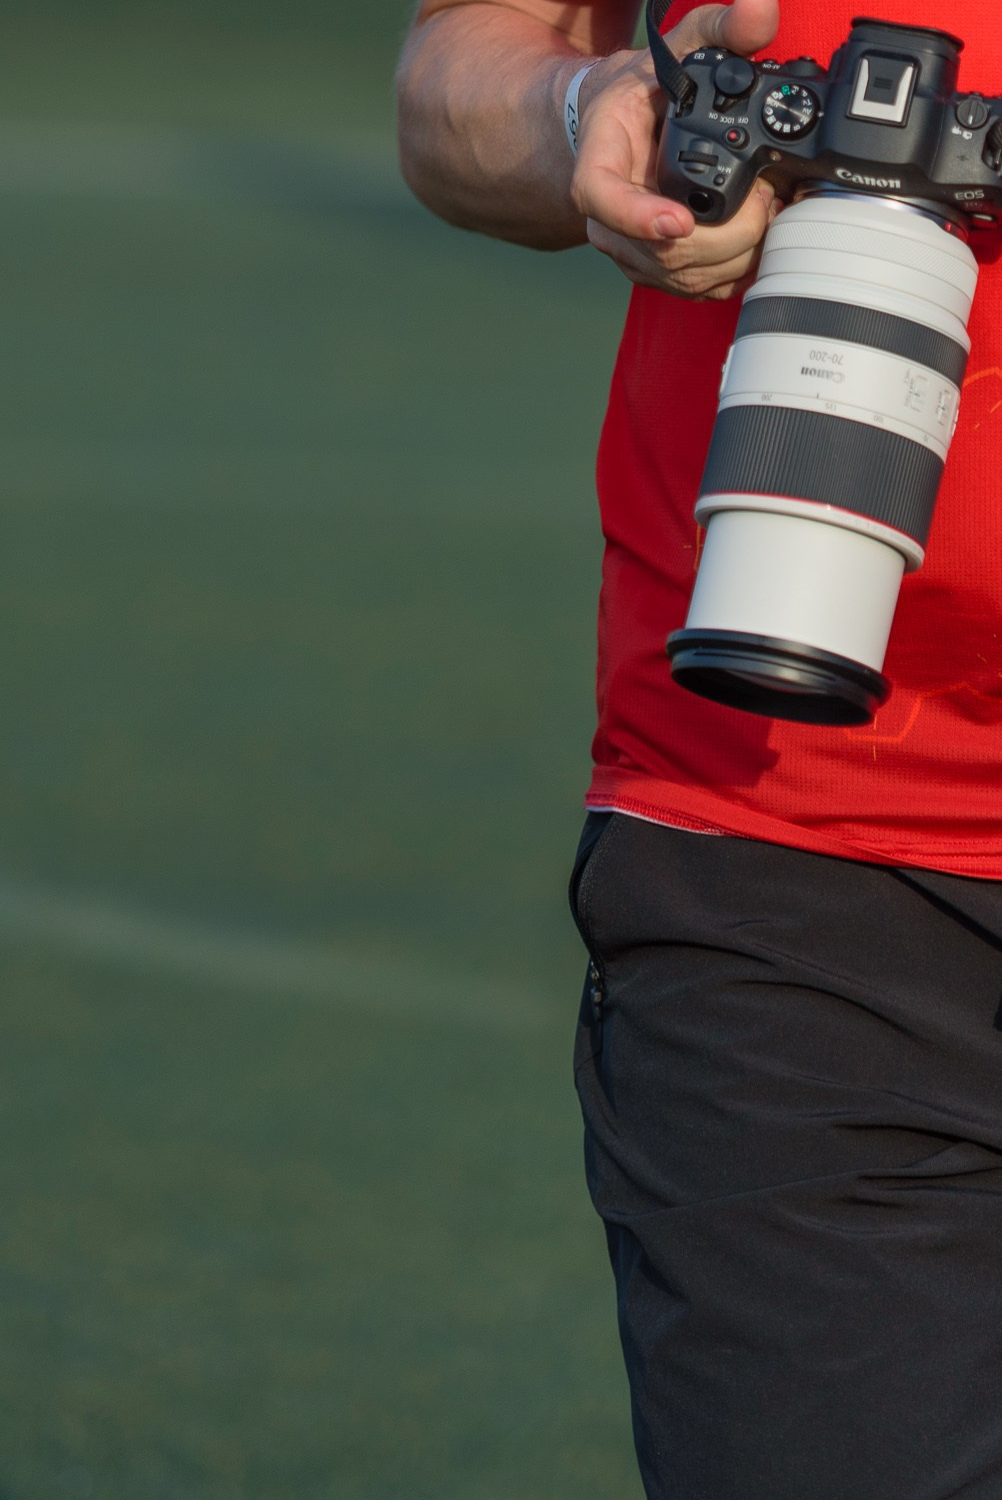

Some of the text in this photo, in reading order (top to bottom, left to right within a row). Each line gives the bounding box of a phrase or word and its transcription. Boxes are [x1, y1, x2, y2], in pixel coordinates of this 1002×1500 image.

[708, 112, 749, 125] OFF LOCK ON
[800, 115, 810, 125] M
[836, 168, 901, 189] Canon
[954, 189, 985, 200] EOS
[809, 349, 844, 366] 70-200
[801, 366, 846, 384] Canon
